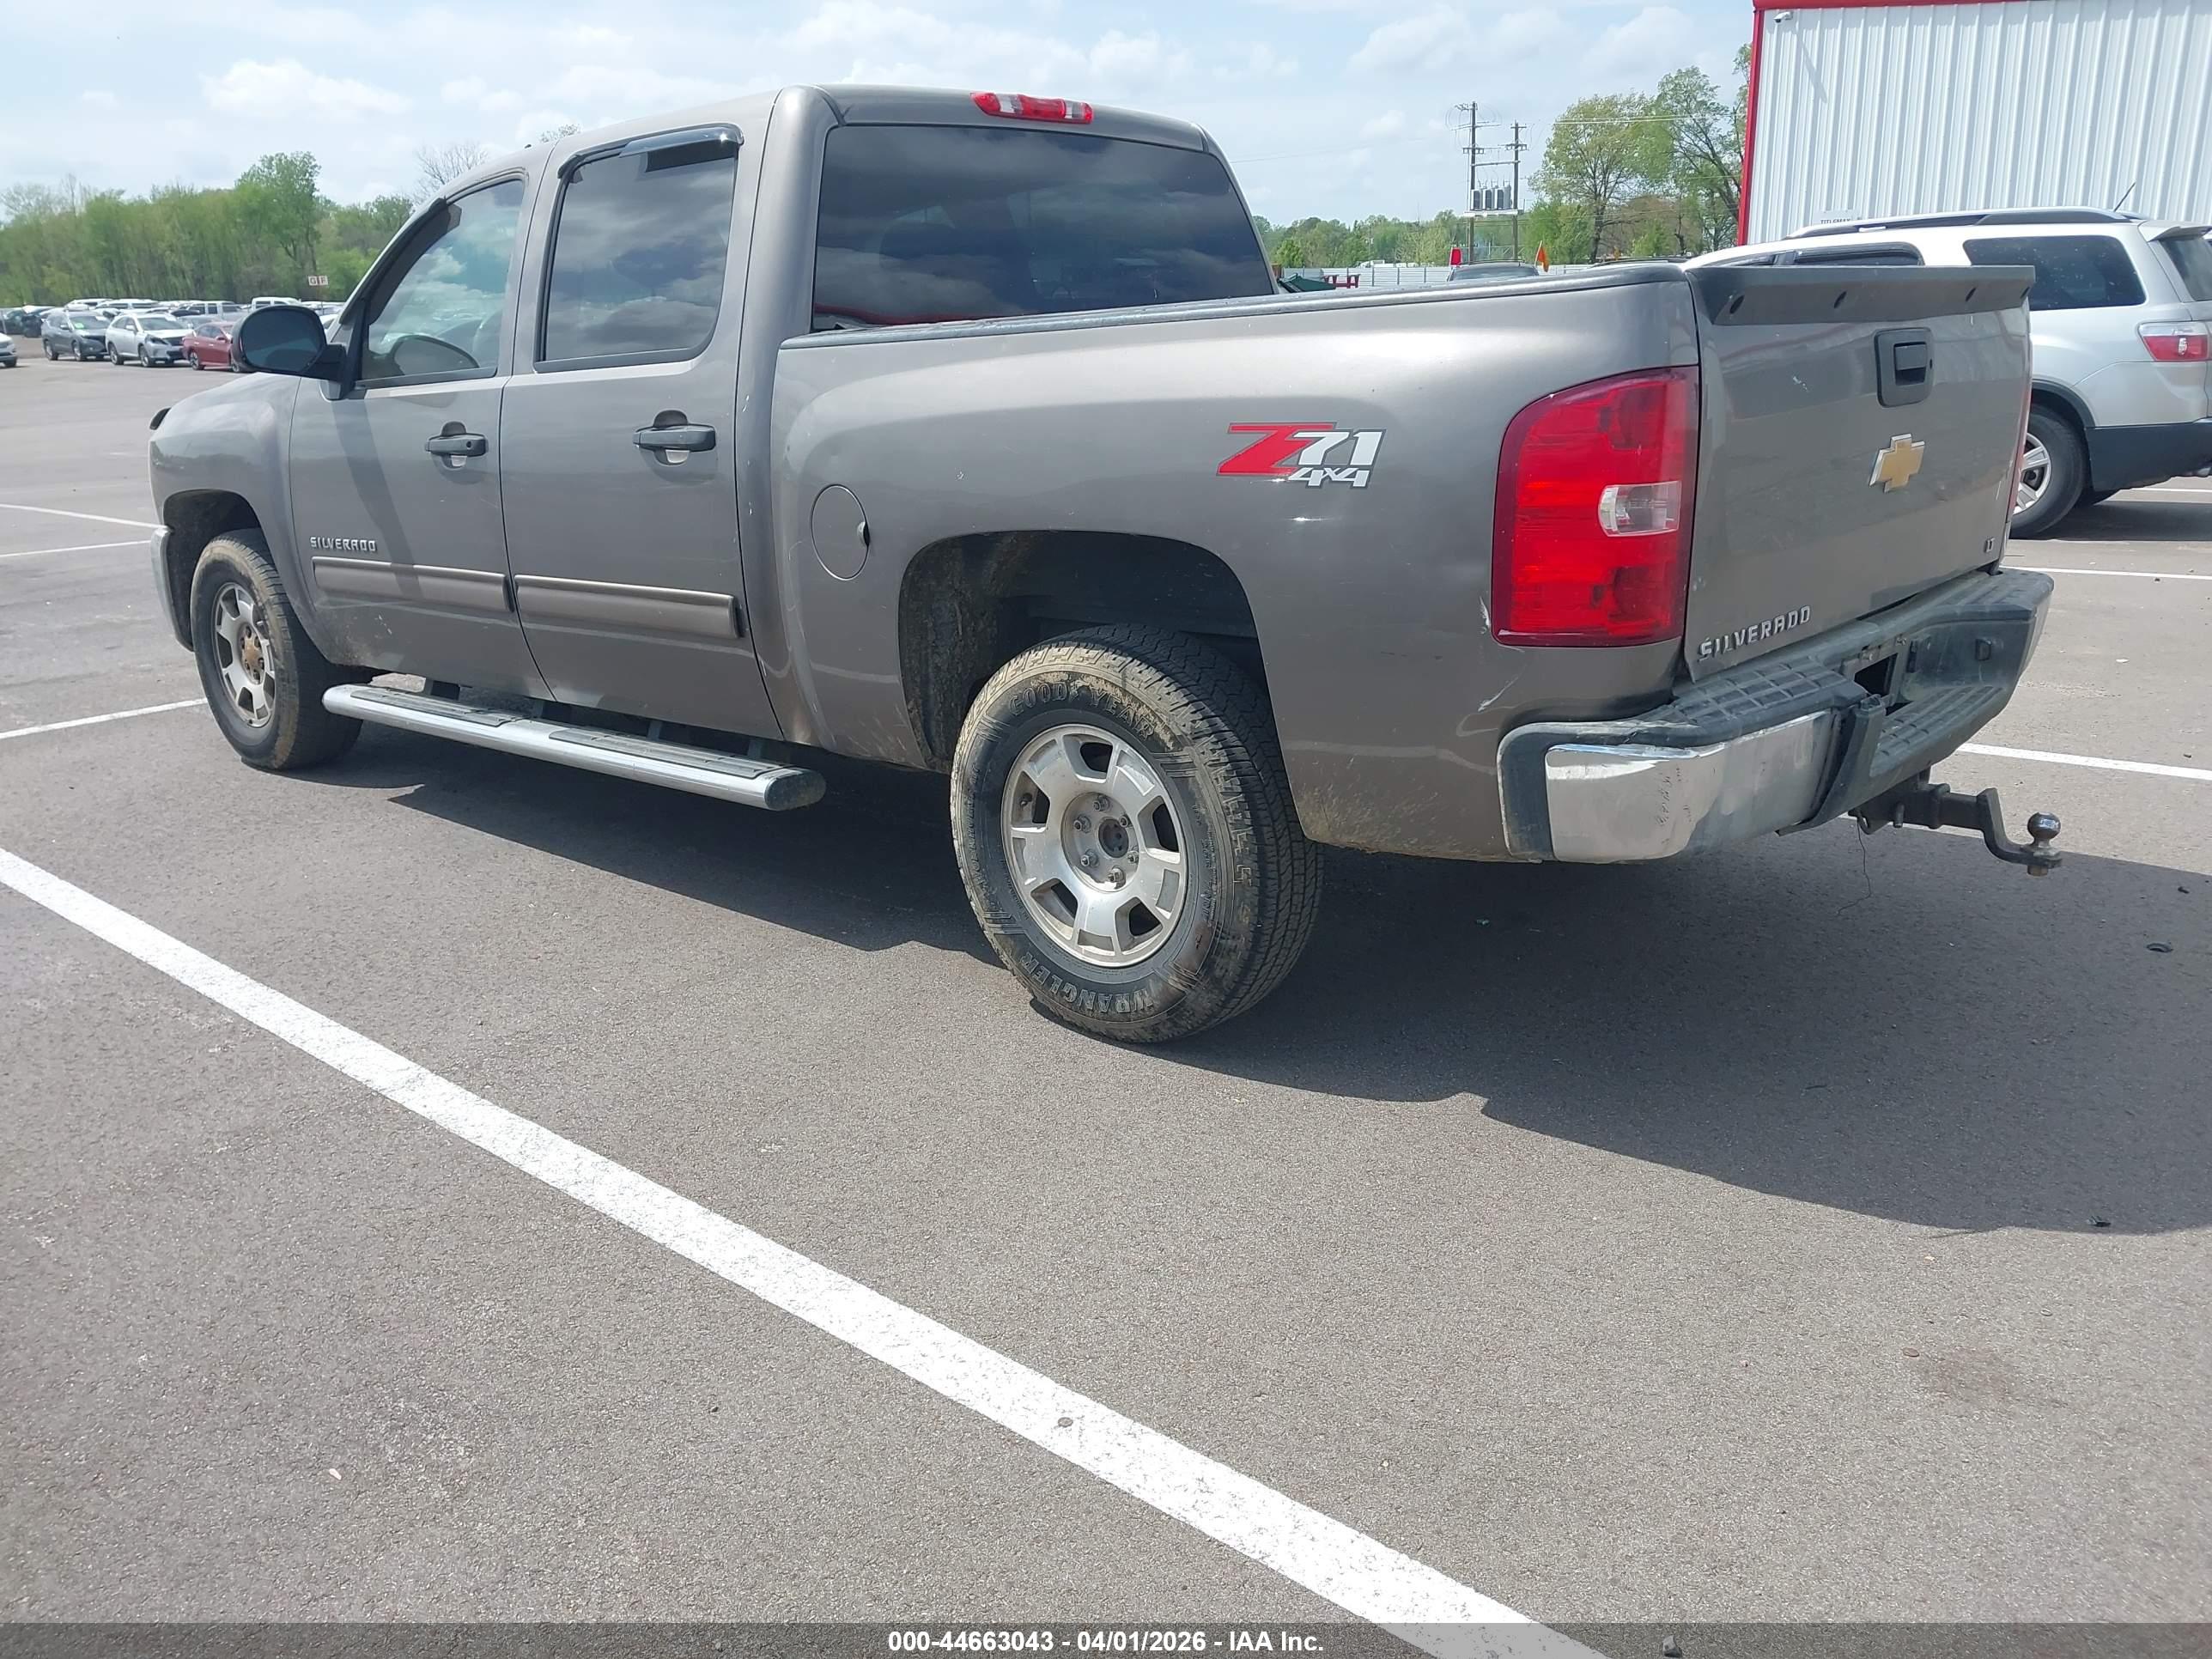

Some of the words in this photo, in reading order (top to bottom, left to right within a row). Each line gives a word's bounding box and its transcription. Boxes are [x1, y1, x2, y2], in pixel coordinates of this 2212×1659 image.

[1216, 422, 1387, 477] Z71
[310, 536, 378, 552] SILVERADO
[1698, 605, 1811, 661] SILVERADO
[1019, 951, 1154, 1014] WRANGLER
